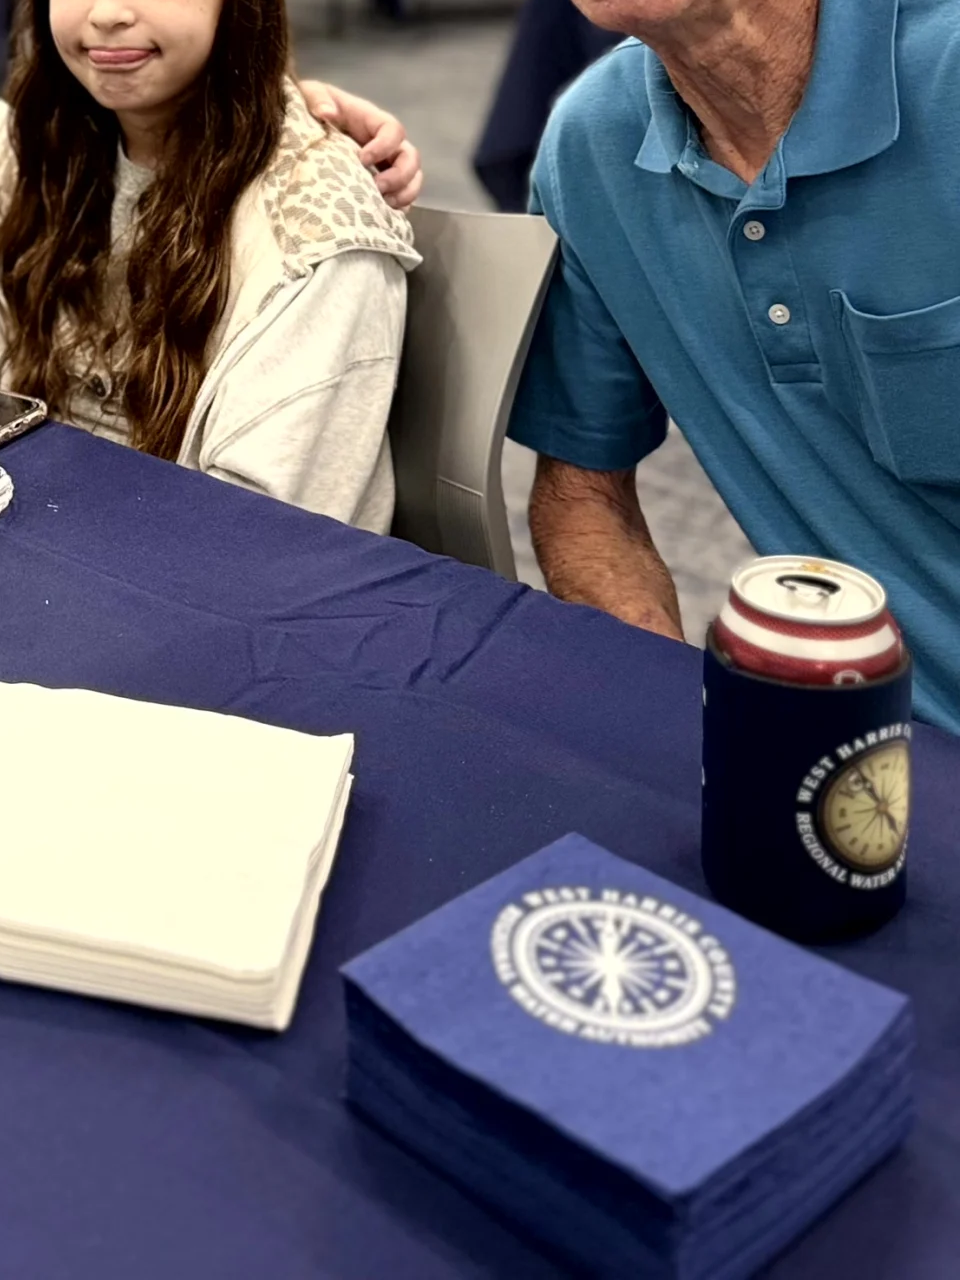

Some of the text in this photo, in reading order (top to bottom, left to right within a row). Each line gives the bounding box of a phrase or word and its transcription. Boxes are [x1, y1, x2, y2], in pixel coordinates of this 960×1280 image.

[797, 756, 835, 802] WEST
[836, 723, 902, 760] HARRIS
[796, 812, 848, 883] REGIONAL
[849, 867, 896, 889] WATER
